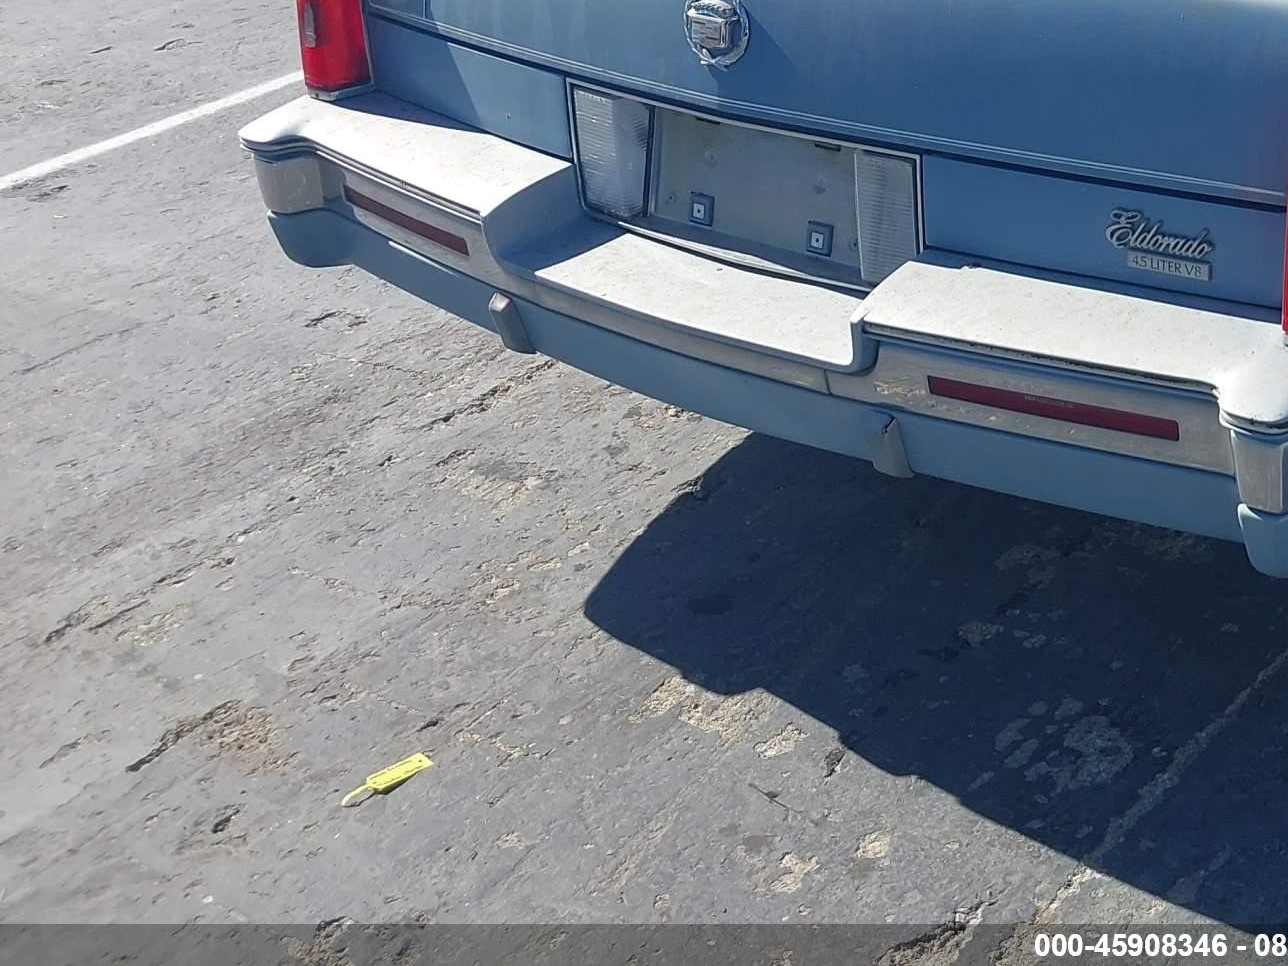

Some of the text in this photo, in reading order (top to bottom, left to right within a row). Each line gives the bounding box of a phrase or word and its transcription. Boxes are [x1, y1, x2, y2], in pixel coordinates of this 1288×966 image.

[1105, 209, 1214, 259] Eldorado
[1150, 257, 1182, 274] LITER
[1184, 265, 1202, 278] V8
